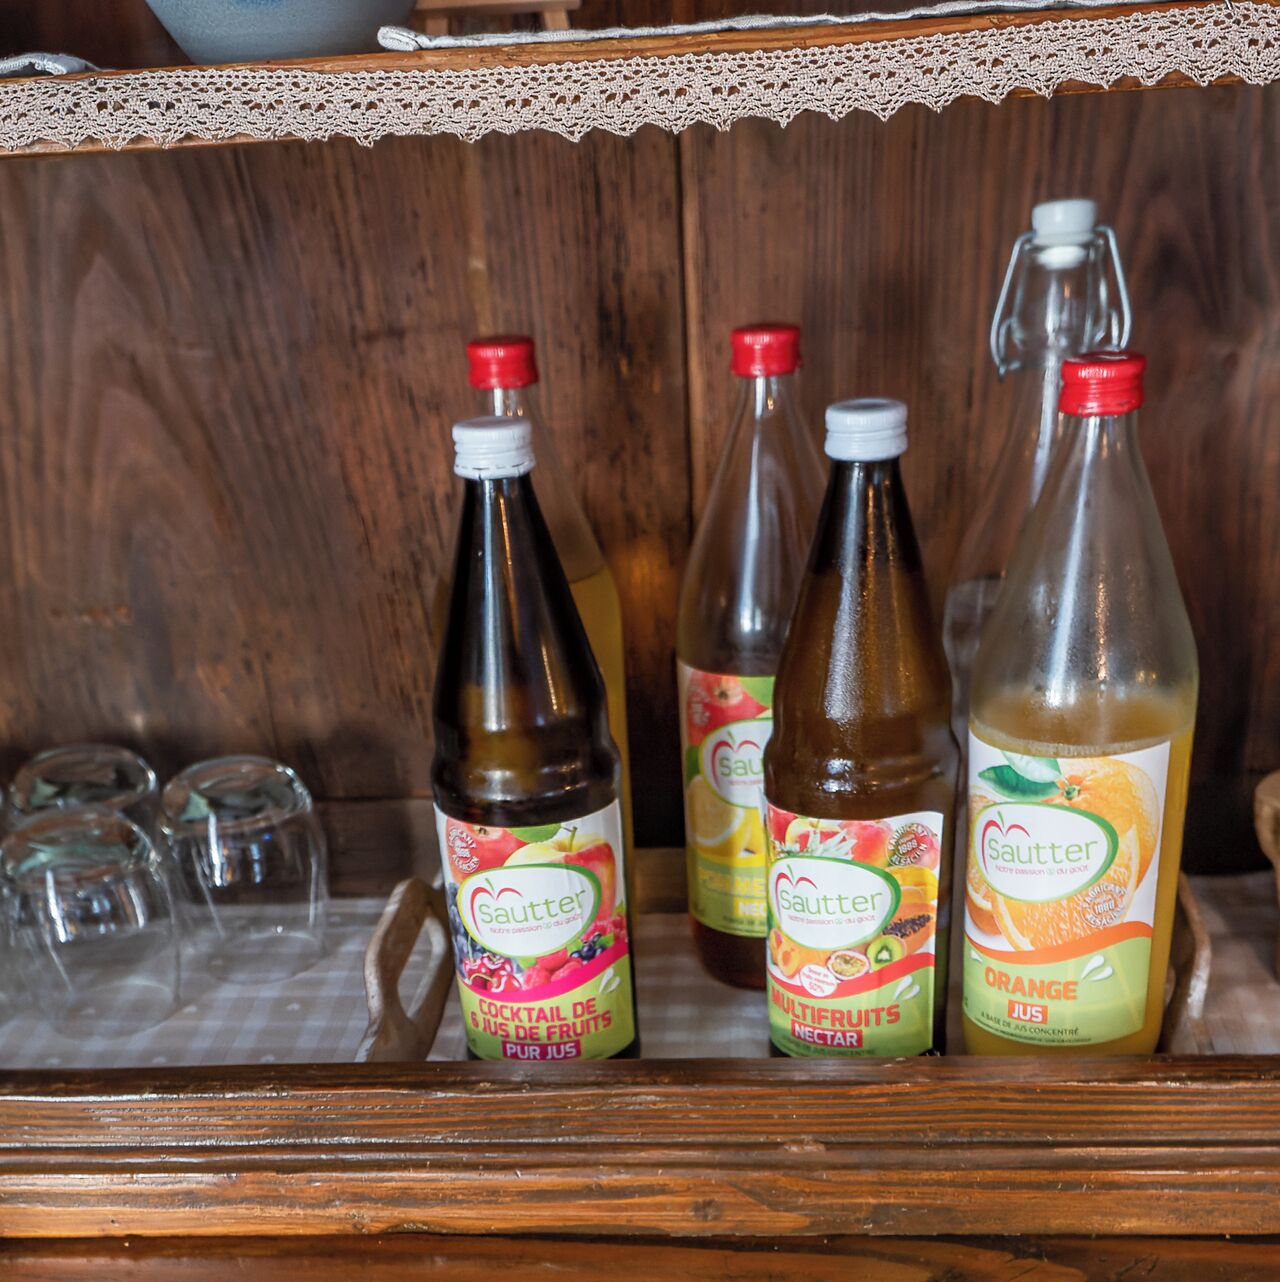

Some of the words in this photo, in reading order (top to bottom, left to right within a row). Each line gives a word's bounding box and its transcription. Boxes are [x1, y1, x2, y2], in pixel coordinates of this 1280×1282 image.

[987, 838, 1098, 865] Sautter
[478, 889, 586, 924] Sautter
[780, 890, 883, 915] Sautter
[985, 966, 1079, 1000] ORANGE
[479, 998, 567, 1024] COCKTAIL
[572, 997, 597, 1019] DE
[771, 985, 900, 1028] MULTIFRUITS
[1012, 1003, 1043, 1023] JUS
[470, 1011, 479, 1028] 6
[481, 1017, 510, 1039] JUS
[515, 1025, 540, 1041] DE
[546, 1010, 612, 1041] FRUITS
[794, 1023, 858, 1047] NECTAR
[505, 1043, 541, 1060] PUR
[546, 1043, 577, 1060] JUS
